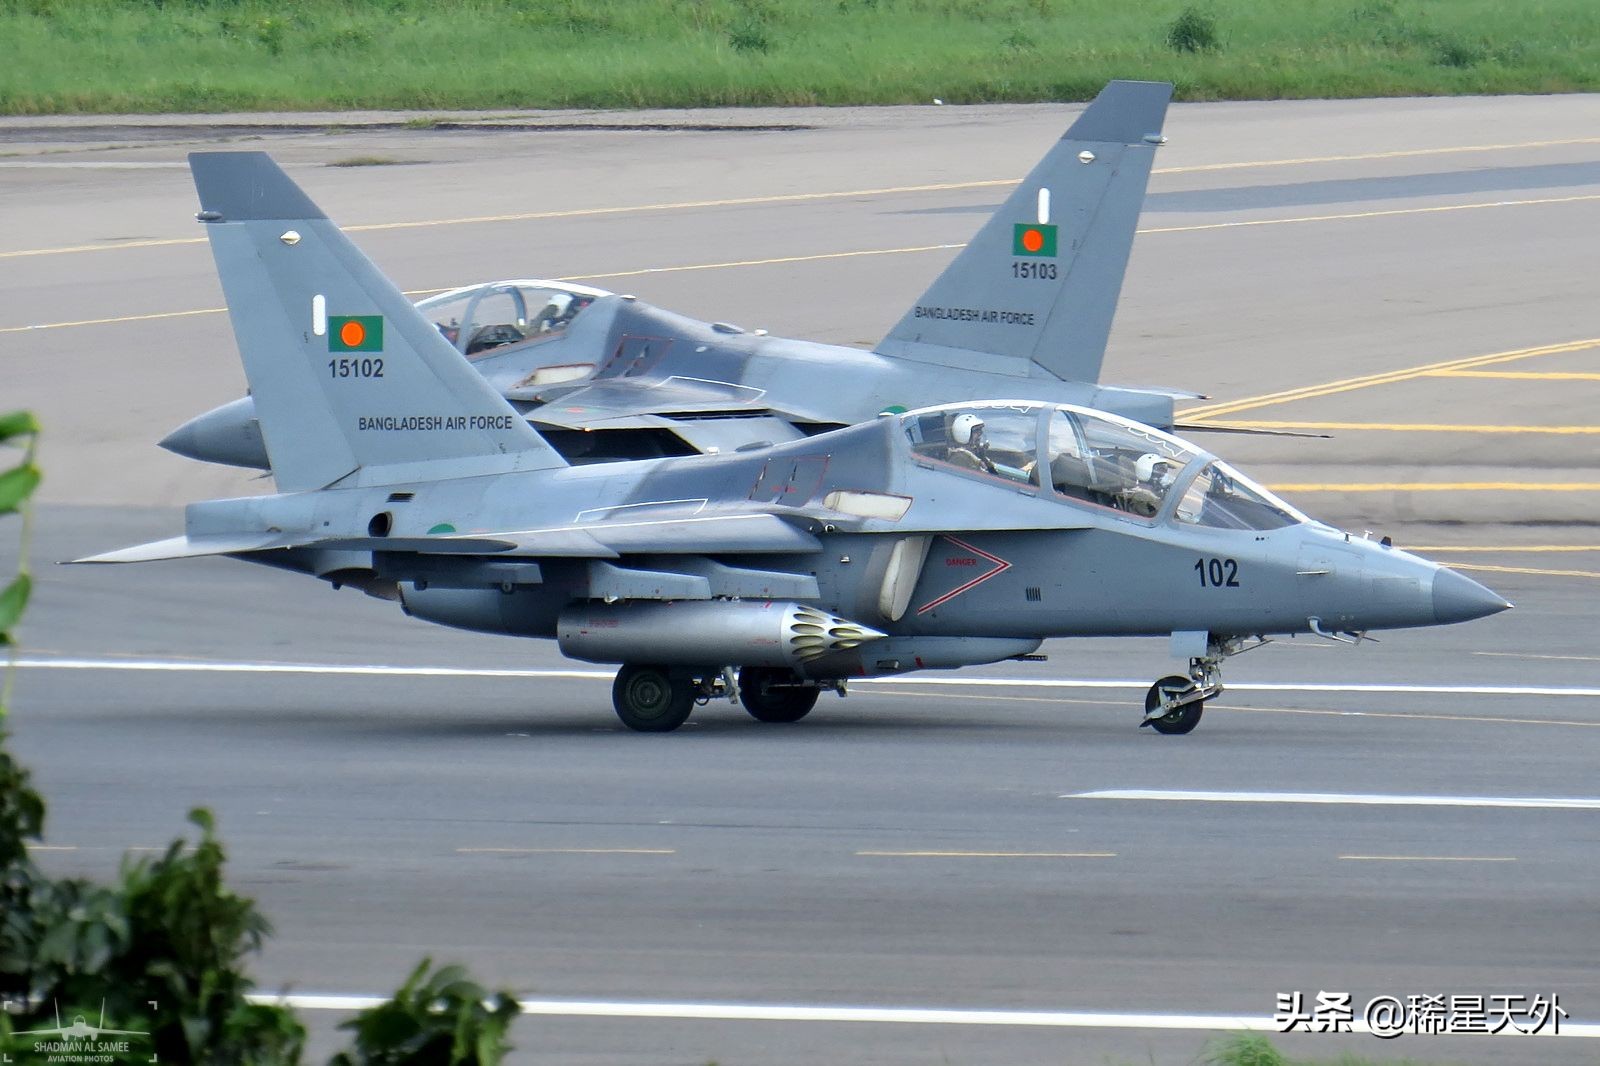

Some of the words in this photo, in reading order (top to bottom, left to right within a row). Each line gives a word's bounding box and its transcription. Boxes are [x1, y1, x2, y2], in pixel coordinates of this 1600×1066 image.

[1012, 262, 1057, 280] 15103
[914, 306, 980, 322] BANGLADESH
[981, 310, 999, 324] AIR
[1000, 312, 1034, 326] FORCE
[328, 359, 384, 378] 15102
[358, 416, 443, 431] BANGLADESH
[445, 416, 467, 430] AIR
[469, 415, 513, 430] FORCE
[945, 557, 978, 567] DANGER
[1194, 558, 1240, 588] 102
